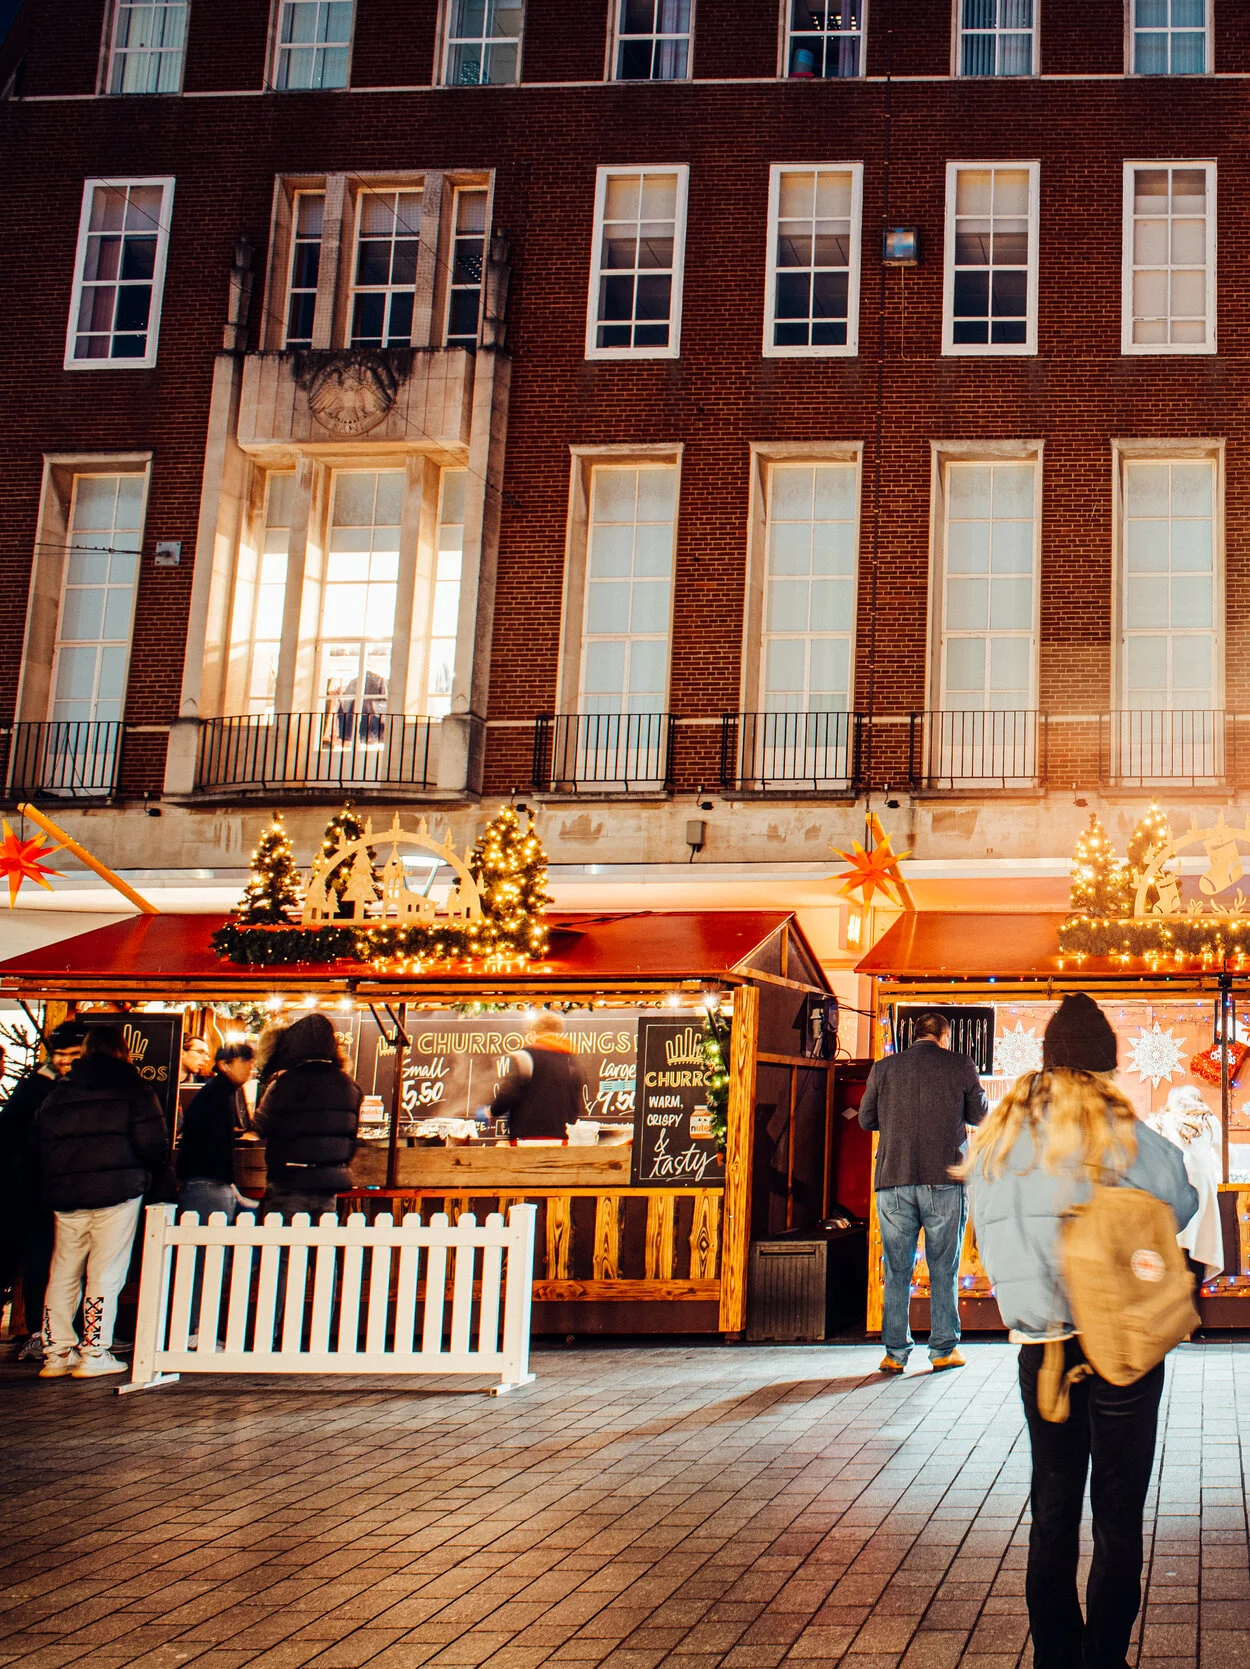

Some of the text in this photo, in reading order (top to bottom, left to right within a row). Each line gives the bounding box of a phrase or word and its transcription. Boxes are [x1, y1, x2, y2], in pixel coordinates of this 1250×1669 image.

[401, 1057, 450, 1079] Small
[600, 1058, 636, 1081] Large
[399, 1080, 445, 1113] 5.50
[649, 1095, 685, 1110] WARM,
[646, 1113, 684, 1128] CRISPY
[653, 1127, 670, 1153] &
[649, 1143, 718, 1182] tasty
